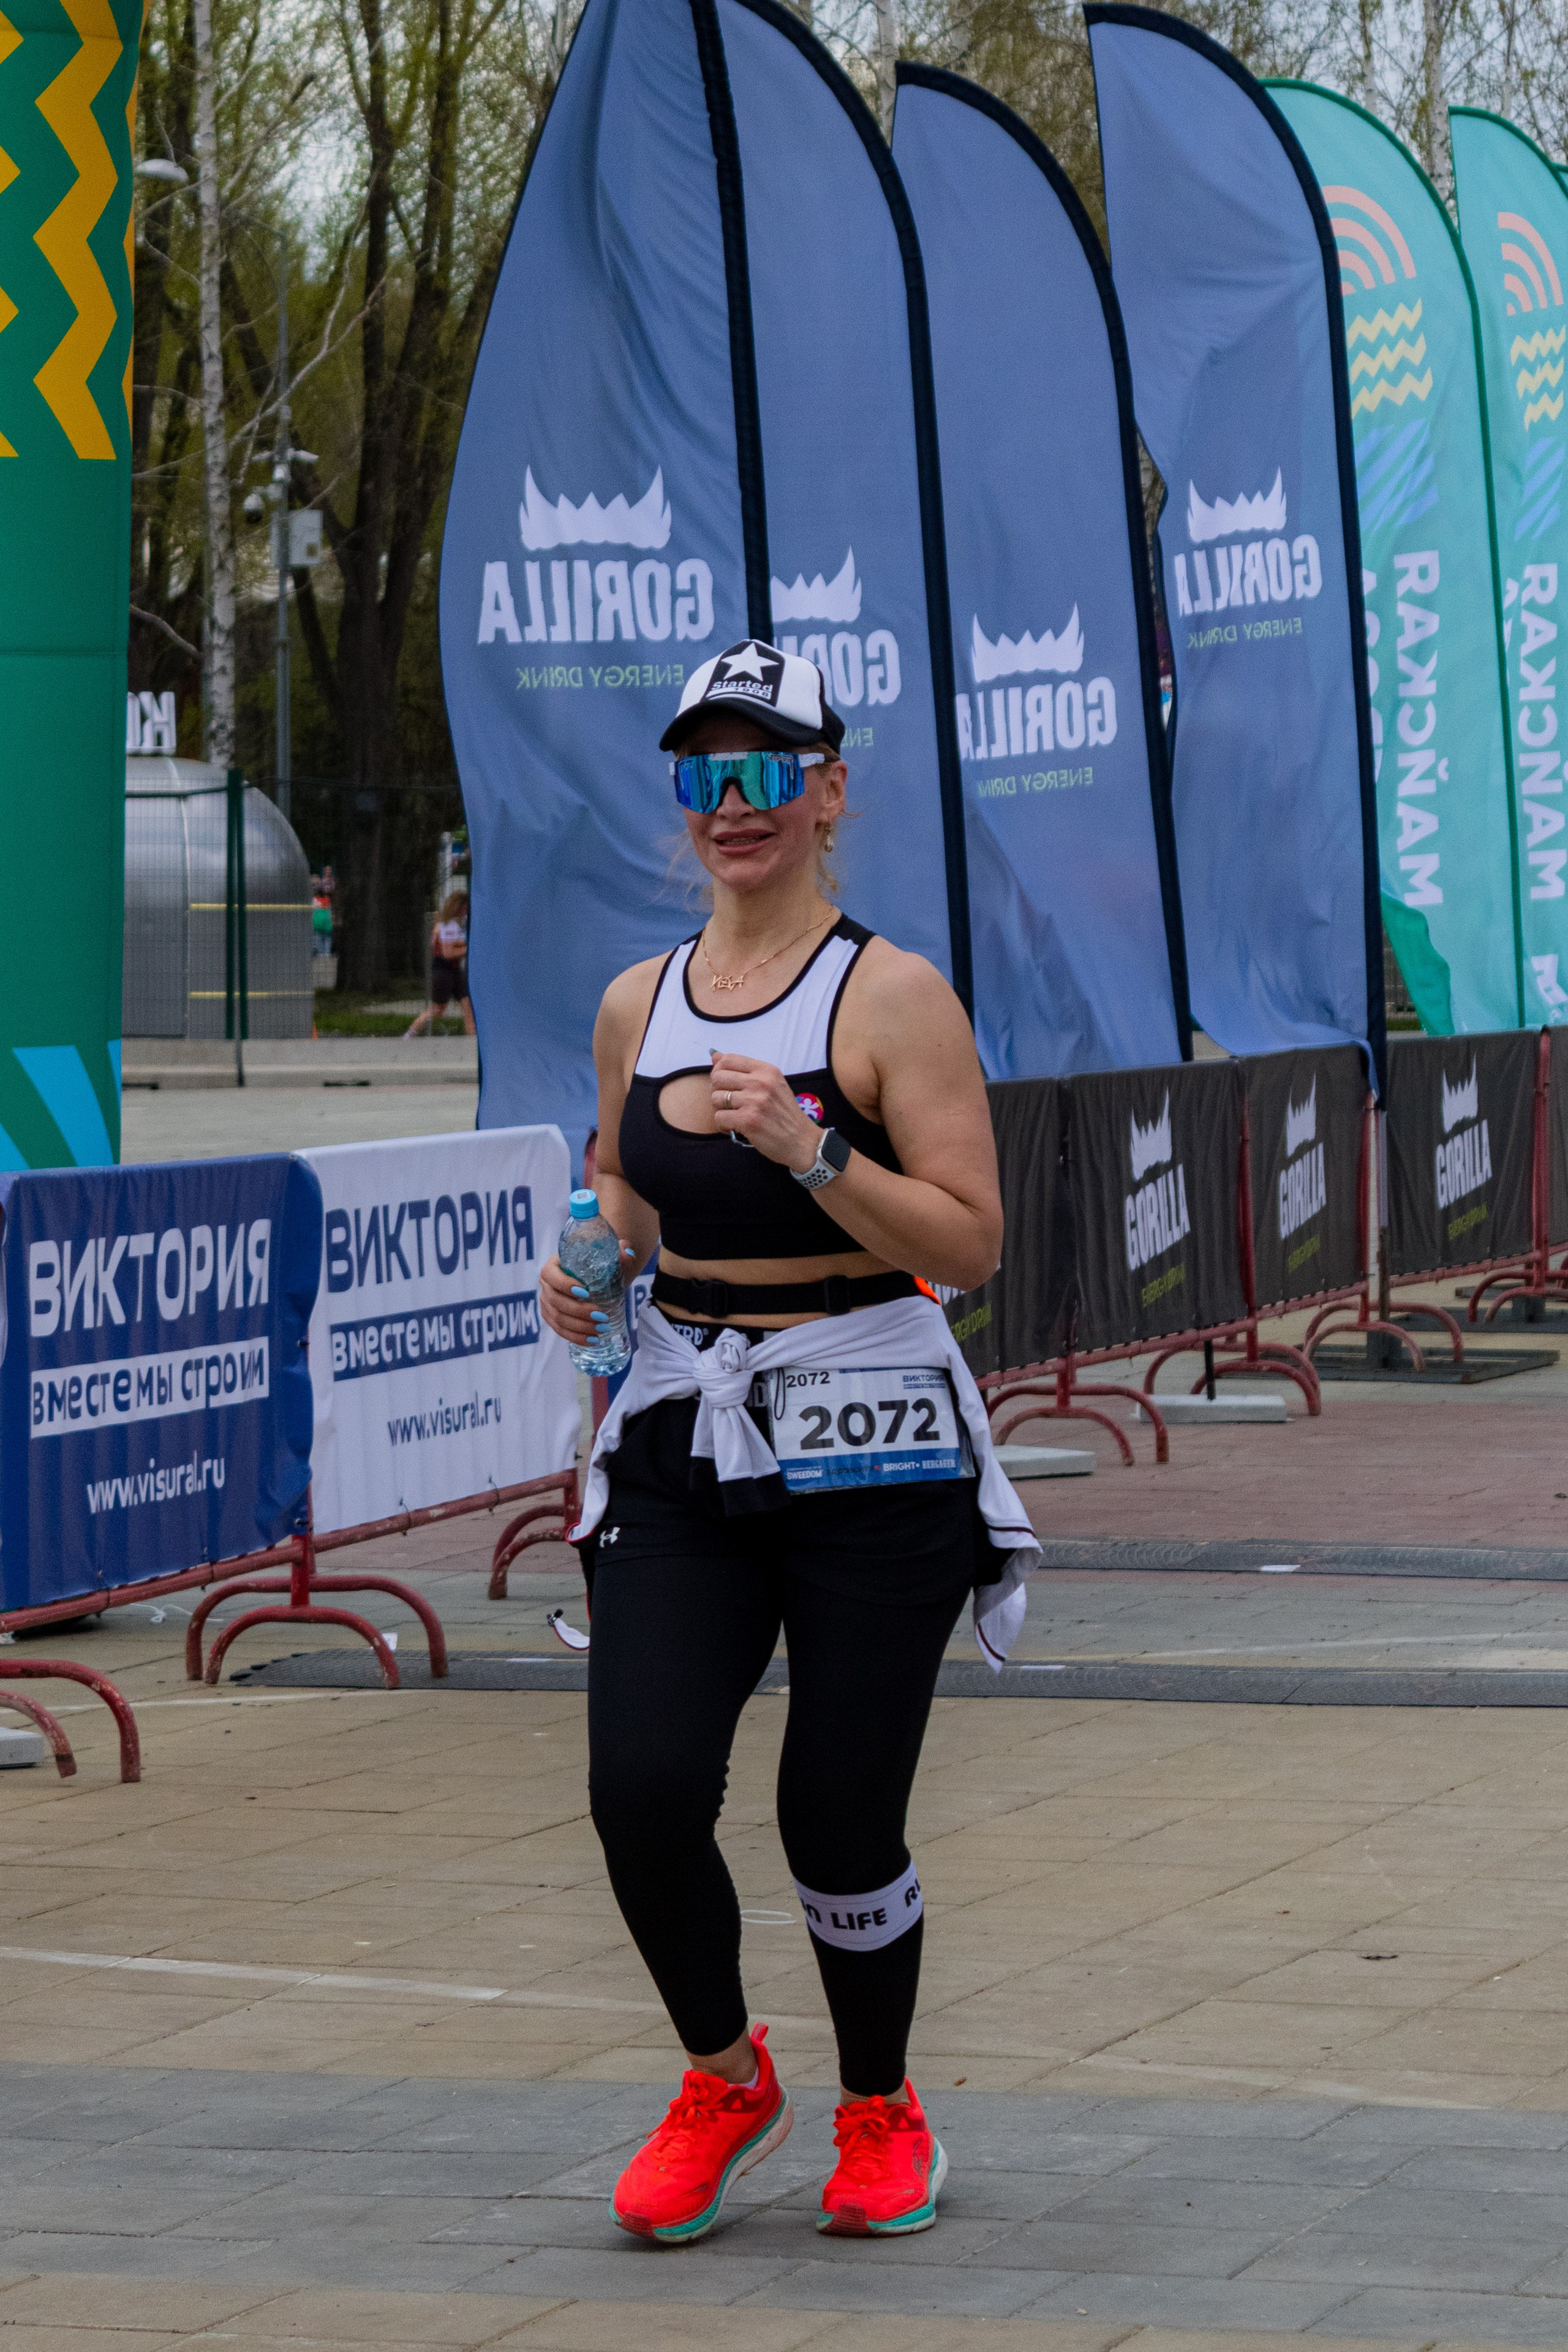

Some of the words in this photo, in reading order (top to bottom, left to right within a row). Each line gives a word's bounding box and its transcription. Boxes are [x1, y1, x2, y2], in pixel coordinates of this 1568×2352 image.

[711, 679, 773, 693] Started
[1279, 1142, 1327, 1240] GORILLA
[1437, 1118, 1493, 1210] GORILLA
[325, 1185, 535, 1293] ВИКТОРИЯ
[1125, 1163, 1191, 1272] GORILLA
[29, 1218, 271, 1338] ВИКТОРИЯ
[786, 1371, 831, 1388] 2072
[388, 1389, 502, 1446] www.visural.ru
[798, 1397, 940, 1450] 2072
[87, 1449, 225, 1514] www.visural.ru
[831, 1907, 888, 1931] LIFE
